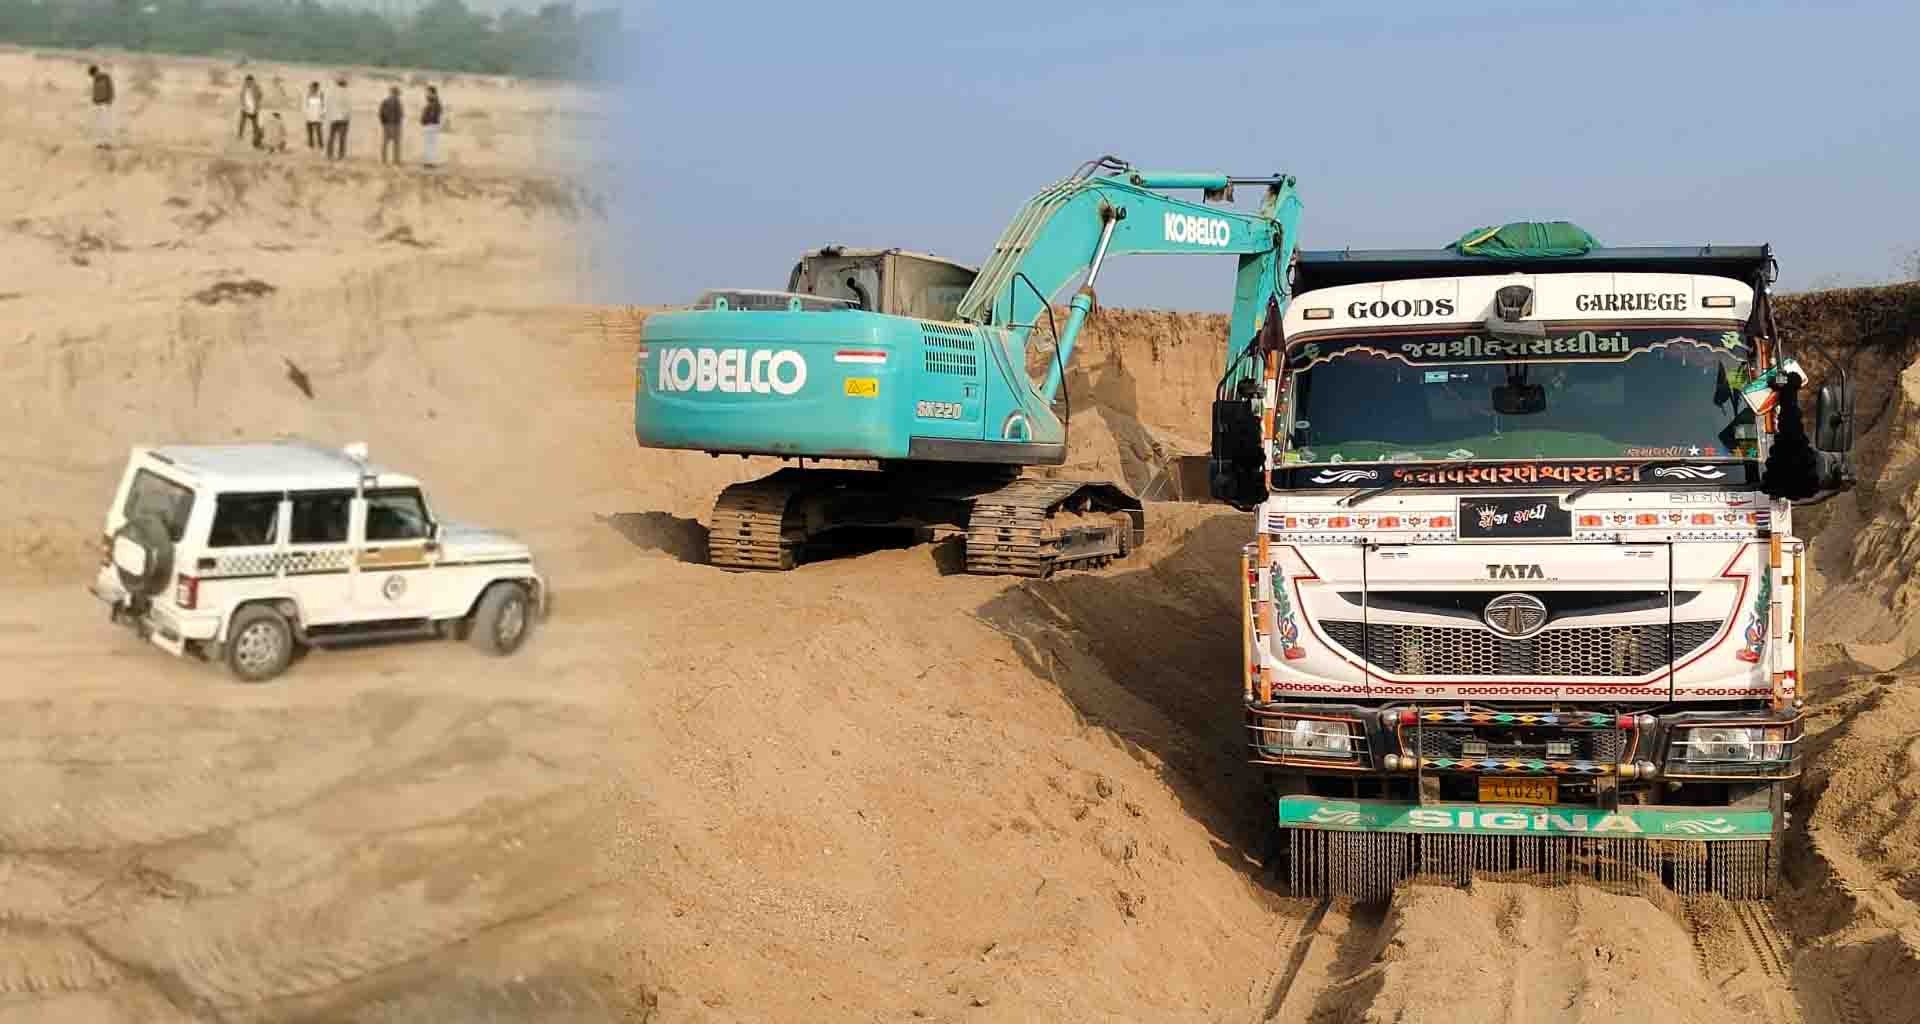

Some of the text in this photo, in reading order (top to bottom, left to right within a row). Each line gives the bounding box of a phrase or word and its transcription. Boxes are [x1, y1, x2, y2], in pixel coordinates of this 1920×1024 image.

[1164, 212, 1230, 247] KOBELCO
[1347, 298, 1456, 319] GOODS
[658, 347, 807, 394] KOBELCO
[1486, 564, 1545, 579] TATA
[1408, 808, 1644, 833] SIGNA
